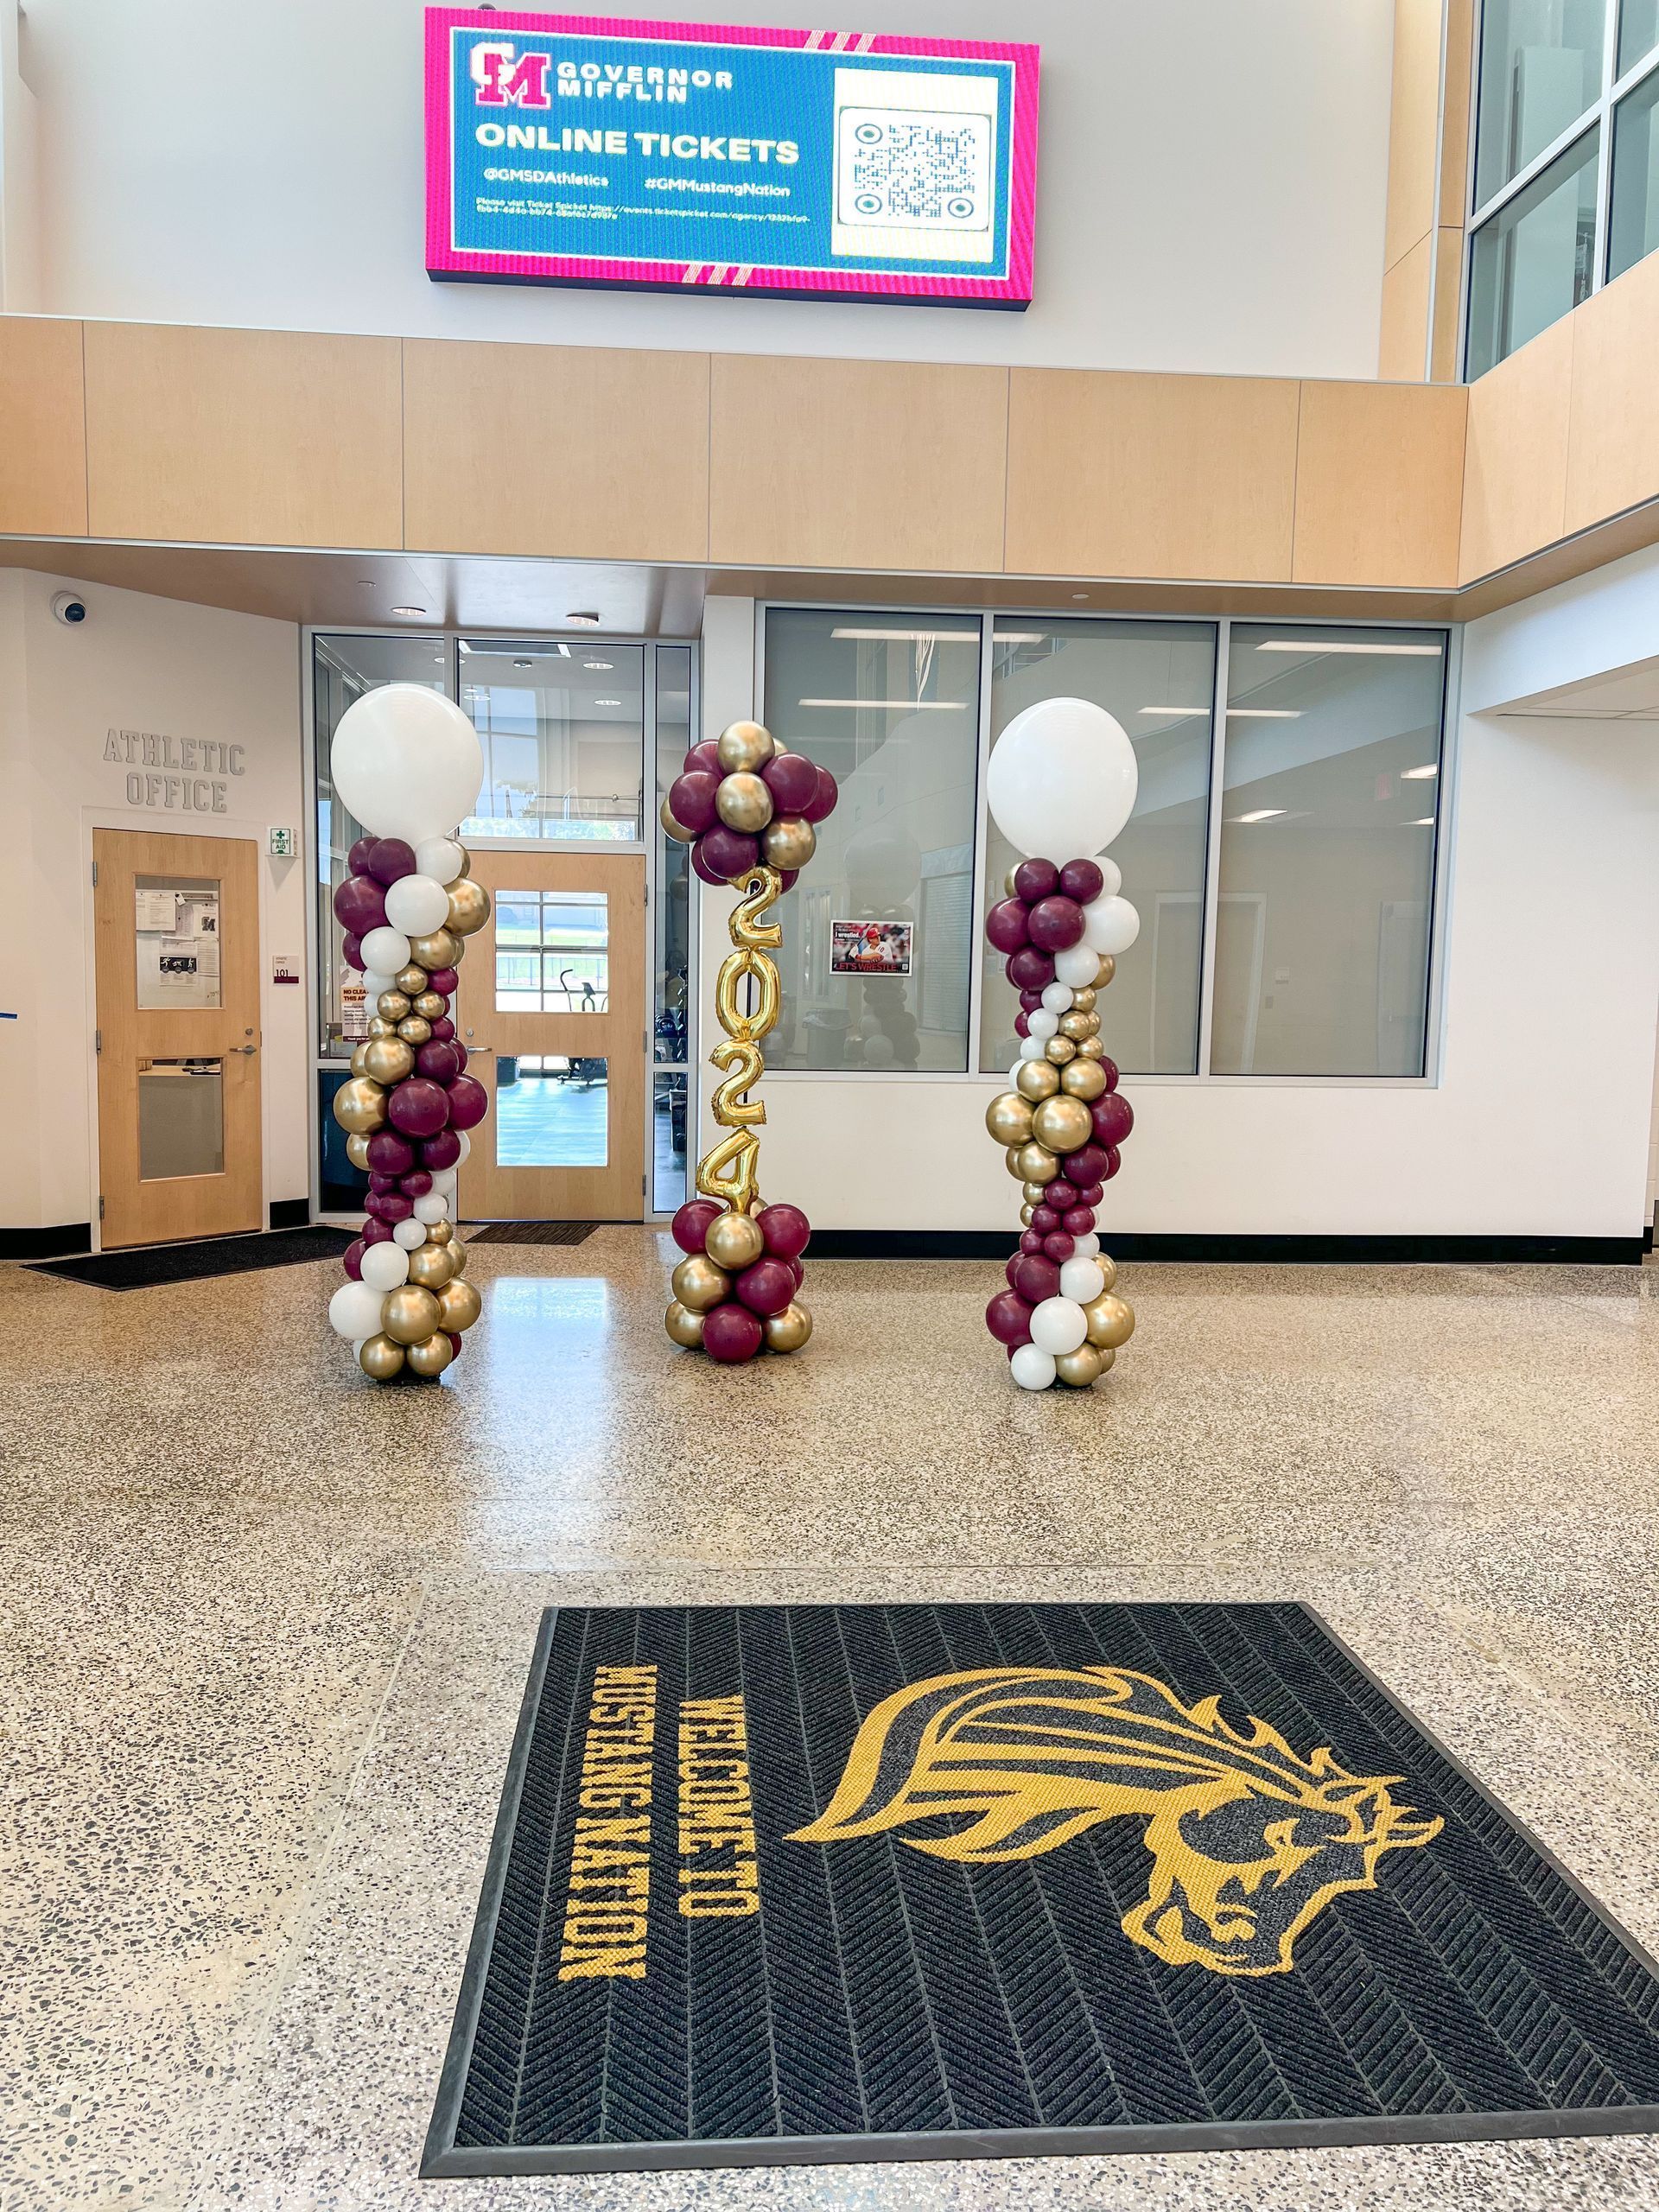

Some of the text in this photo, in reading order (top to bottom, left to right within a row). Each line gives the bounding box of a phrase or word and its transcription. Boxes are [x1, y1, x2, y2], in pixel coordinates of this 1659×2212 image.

[556, 62, 733, 89] GOVERNOR
[557, 79, 687, 104] MIFFLIN
[475, 123, 799, 164] ONLINE TICKETS
[483, 168, 791, 197] @GMSDAthletics #GMMustangNation
[476, 197, 505, 206] Please
[526, 200, 553, 209] Ticket
[103, 728, 245, 776] ATHLETIC
[126, 772, 227, 813] OFFICE
[276, 969, 289, 977] 101
[858, 963, 896, 972] WRESTLE
[696, 865, 784, 1213] 2024
[558, 1665, 658, 1980] MUSTANG NATION
[678, 1695, 760, 1917] WELCOME TO
